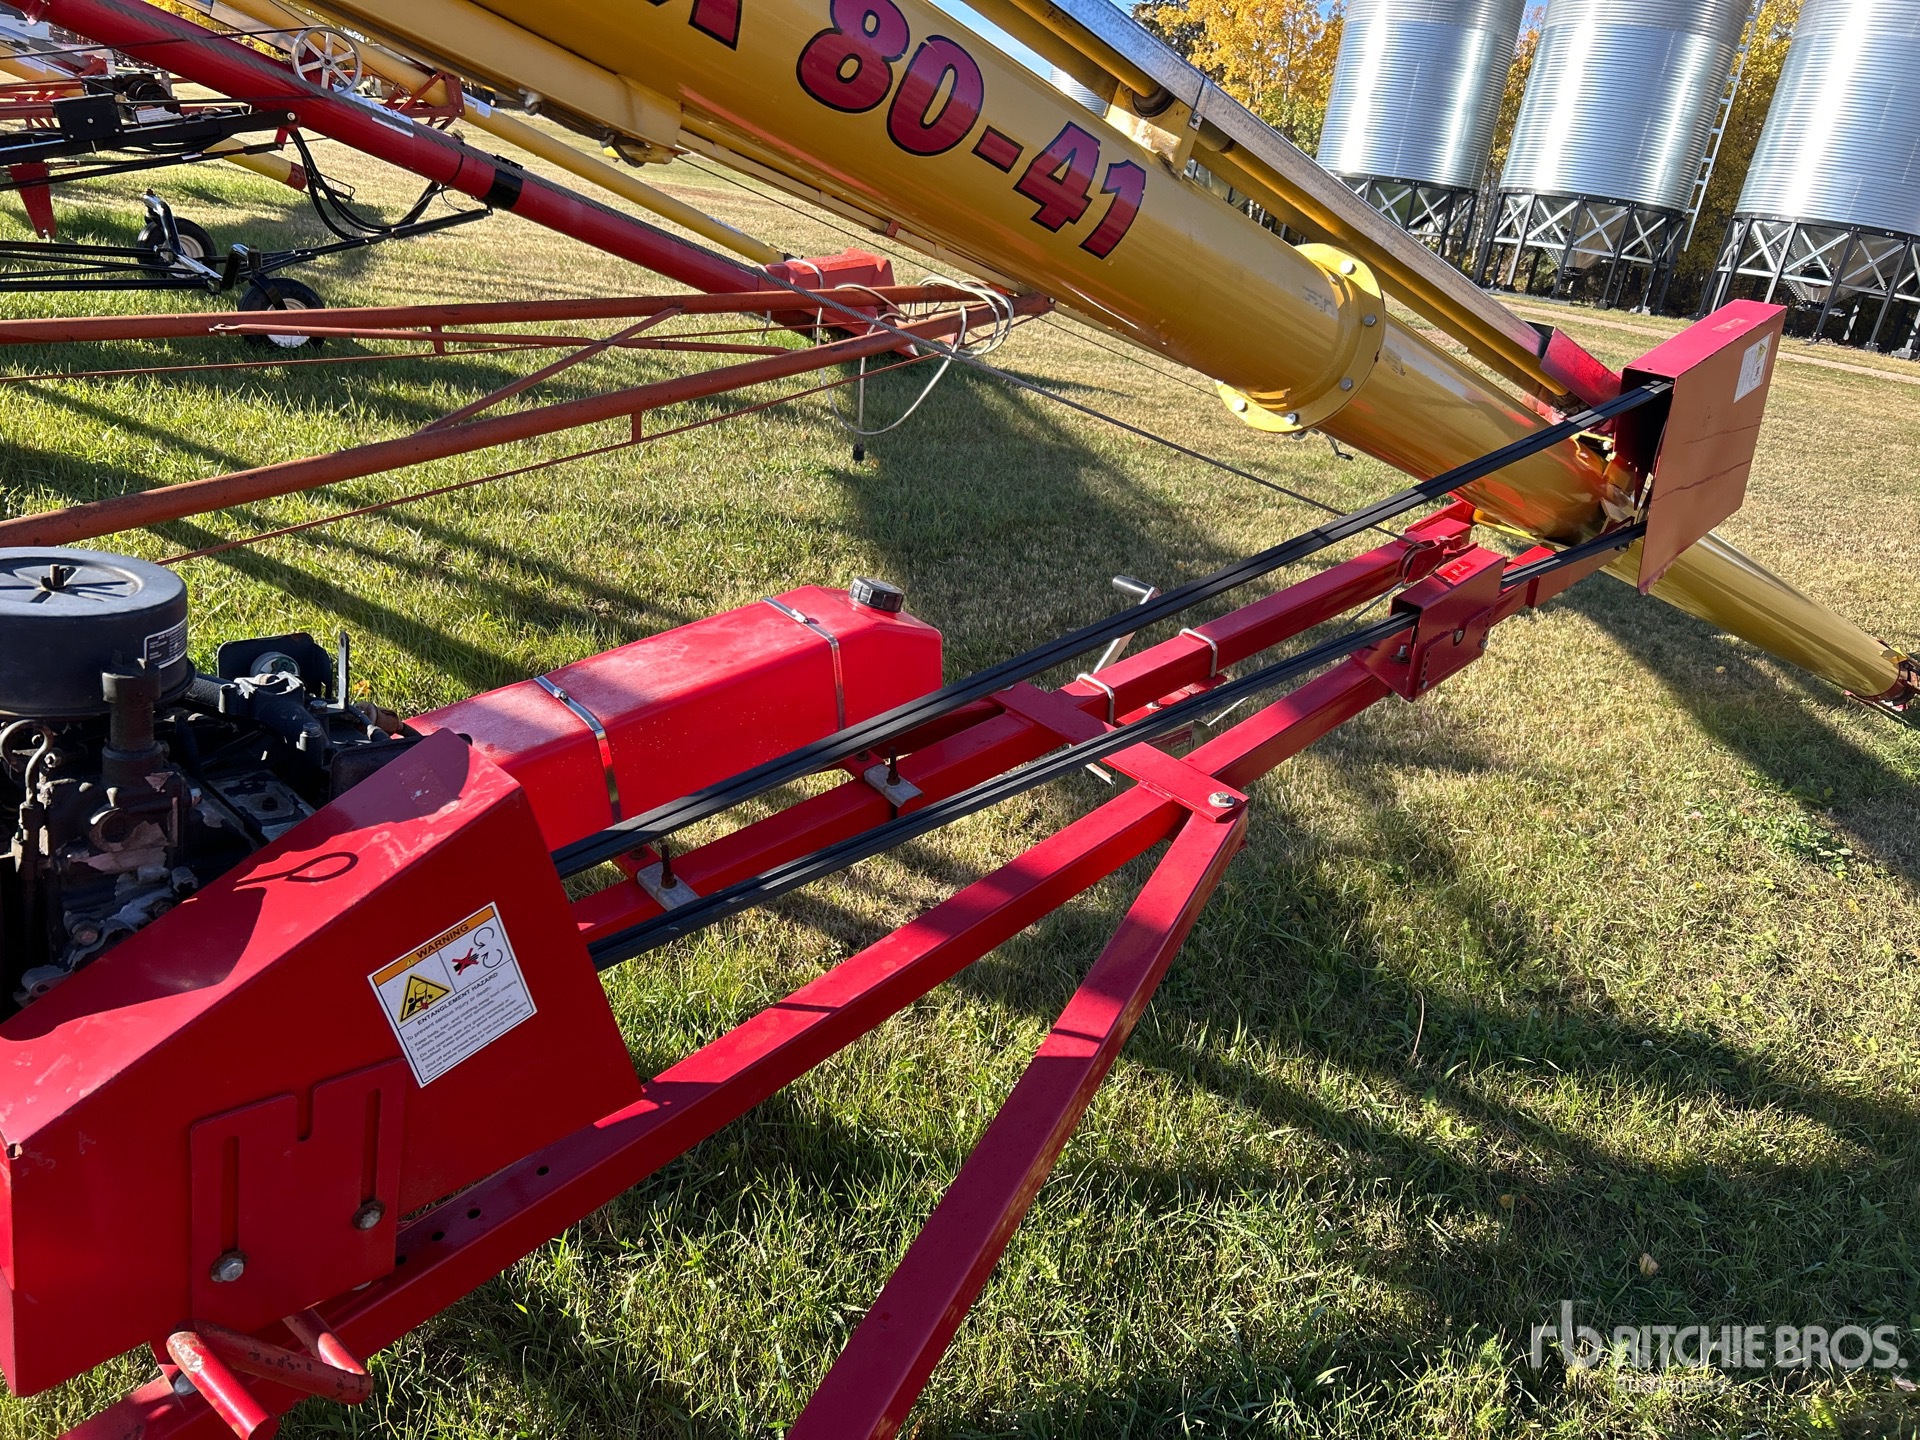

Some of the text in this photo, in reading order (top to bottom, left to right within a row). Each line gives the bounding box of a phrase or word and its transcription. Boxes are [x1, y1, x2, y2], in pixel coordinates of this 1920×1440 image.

[797, 0, 1146, 260] 80-41
[416, 923, 469, 959] WARNING
[414, 1022, 434, 1037] prevent
[435, 1009, 453, 1023] serious
[455, 1000, 468, 1011] injury
[417, 972, 498, 1025] ENTANGLEMENT HAZARD
